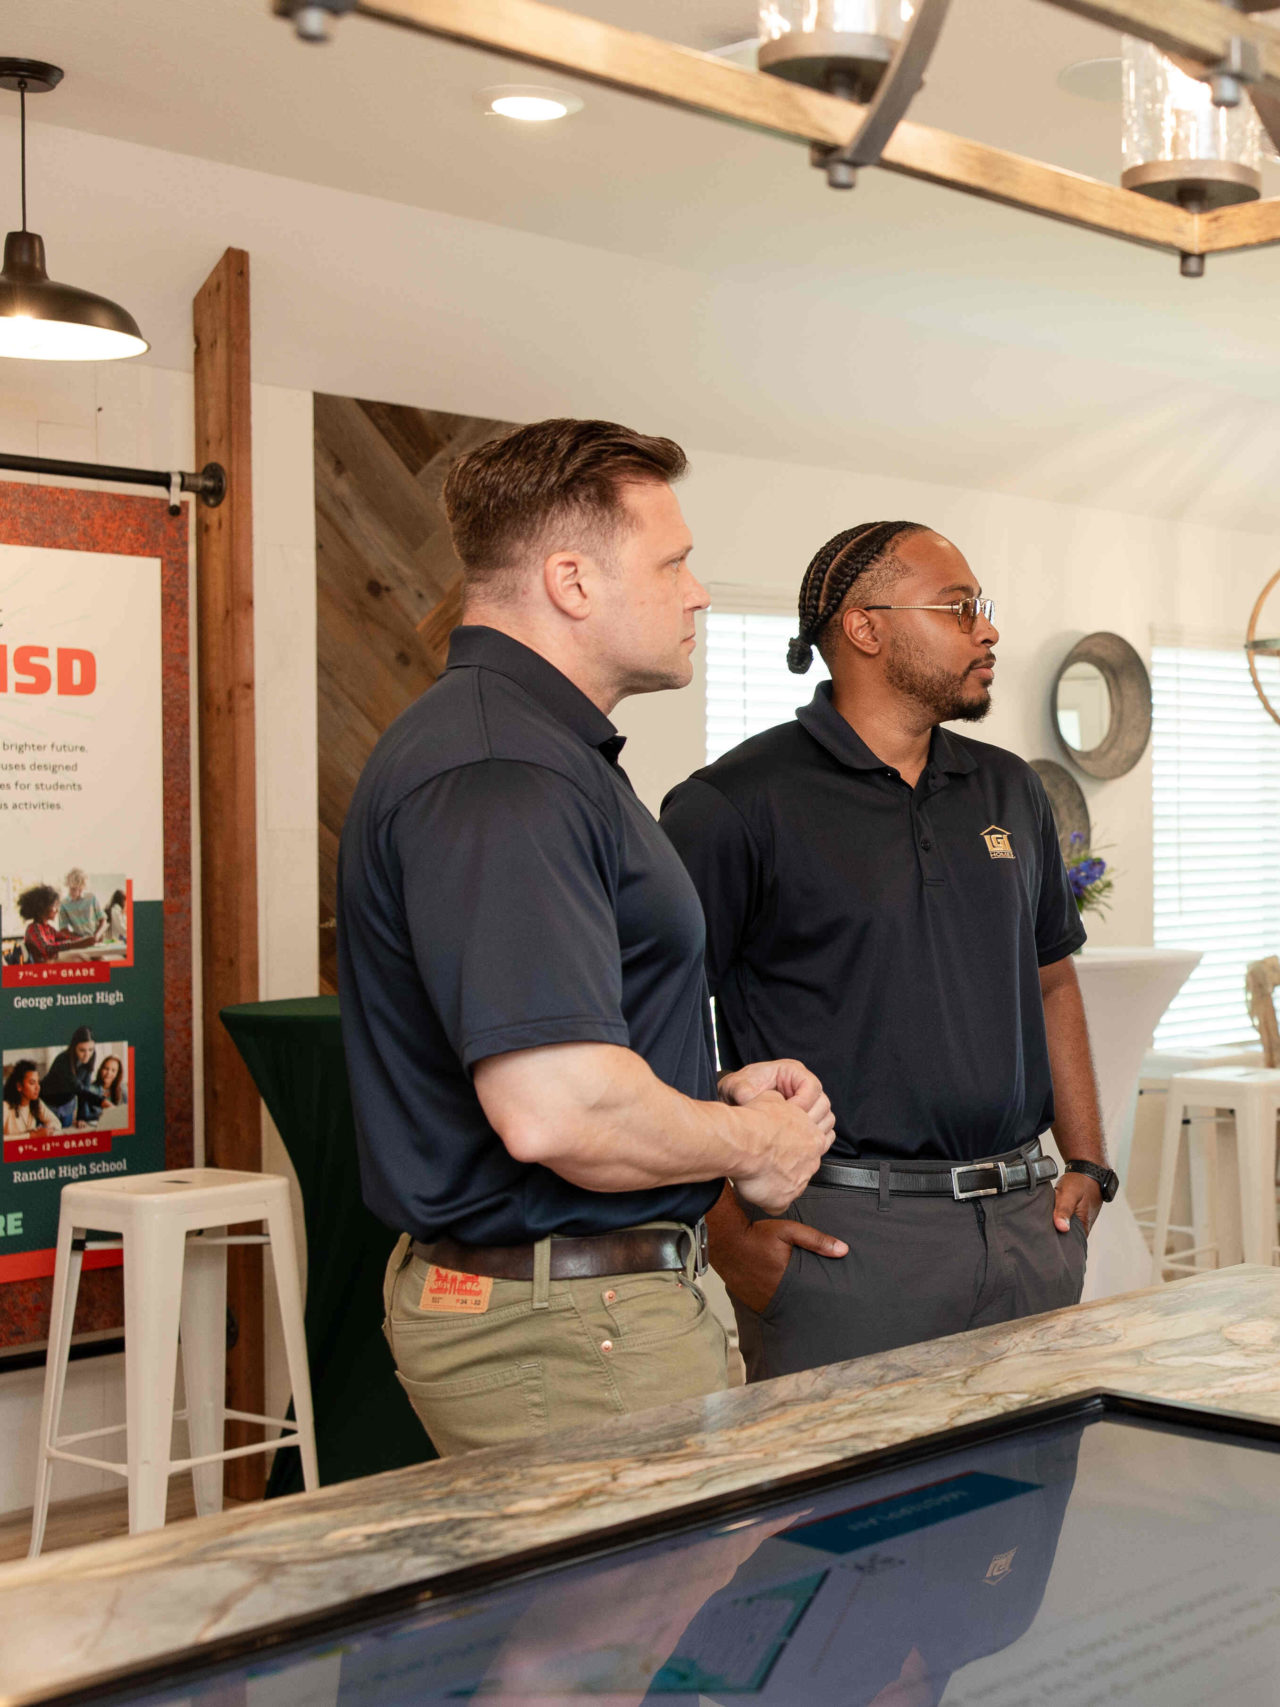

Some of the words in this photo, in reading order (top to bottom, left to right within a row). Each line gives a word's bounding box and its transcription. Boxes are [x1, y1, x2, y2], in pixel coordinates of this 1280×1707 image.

[2, 741, 47, 754] brighter
[1, 763, 26, 771] uses
[29, 761, 78, 774] designed
[14, 780, 31, 790] for
[35, 780, 83, 791] students
[60, 967, 95, 978] GRADE
[13, 996, 54, 1010] George
[56, 992, 93, 1006] Junior
[95, 990, 124, 1006] High
[63, 1138, 98, 1149] GRADE
[12, 1166, 56, 1183] Randle
[58, 1162, 87, 1179] High
[89, 1158, 127, 1174] School
